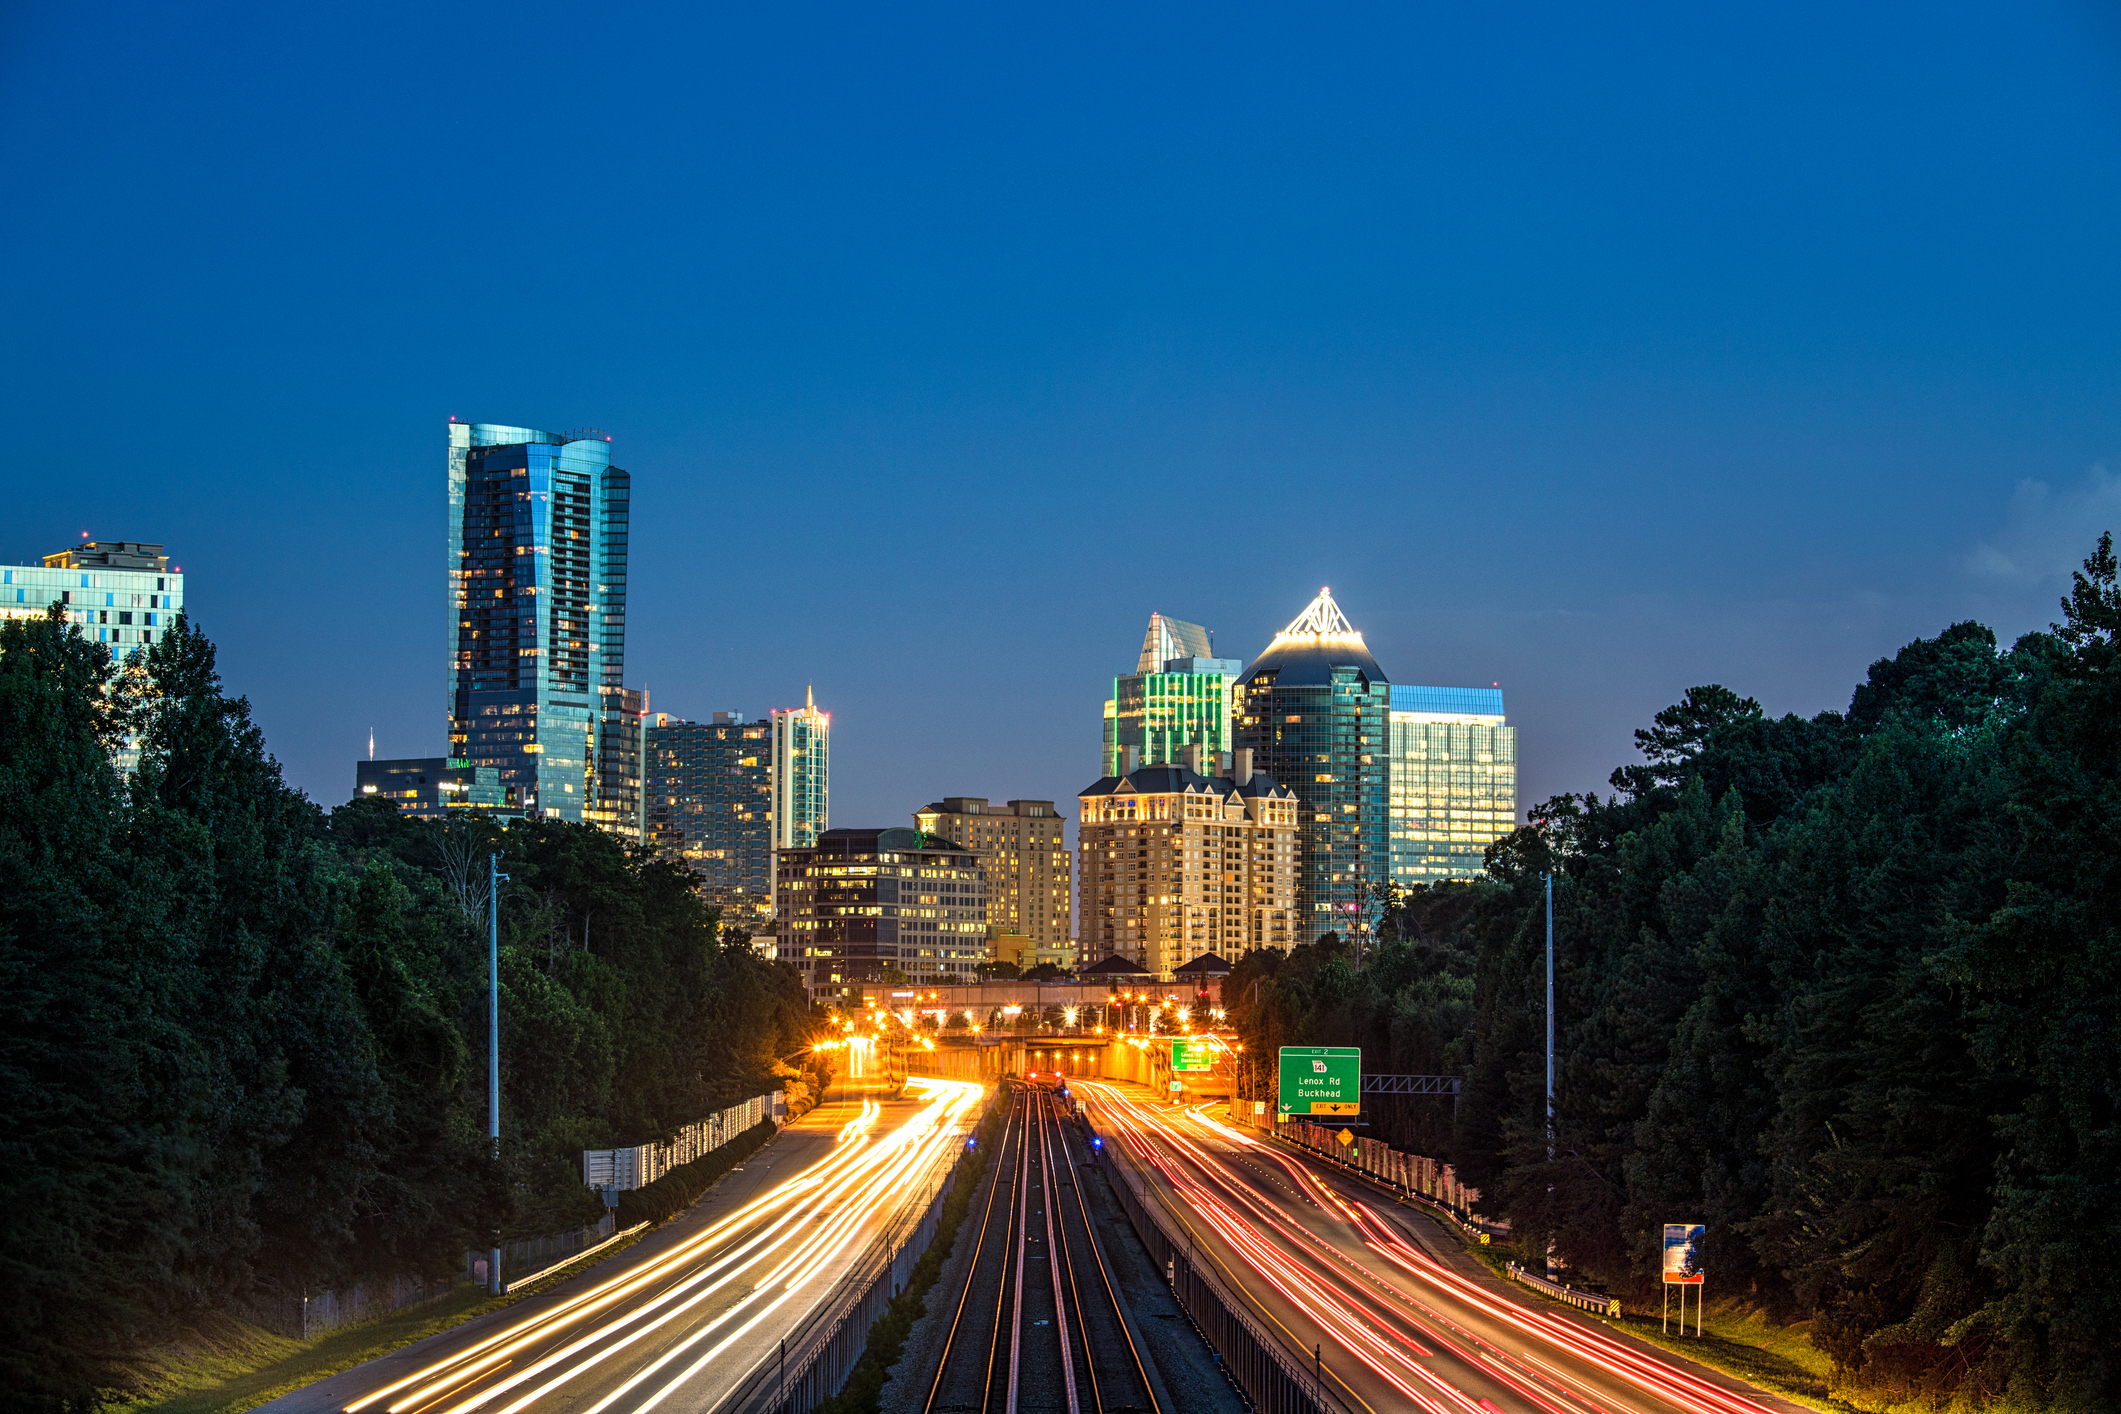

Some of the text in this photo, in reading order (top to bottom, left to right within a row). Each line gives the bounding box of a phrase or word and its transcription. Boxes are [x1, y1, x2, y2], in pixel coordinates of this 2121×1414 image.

[1314, 1064, 1325, 1072] 141
[1298, 1077, 1341, 1086] Lenox Rd
[1298, 1088, 1341, 1098] Buckhead
